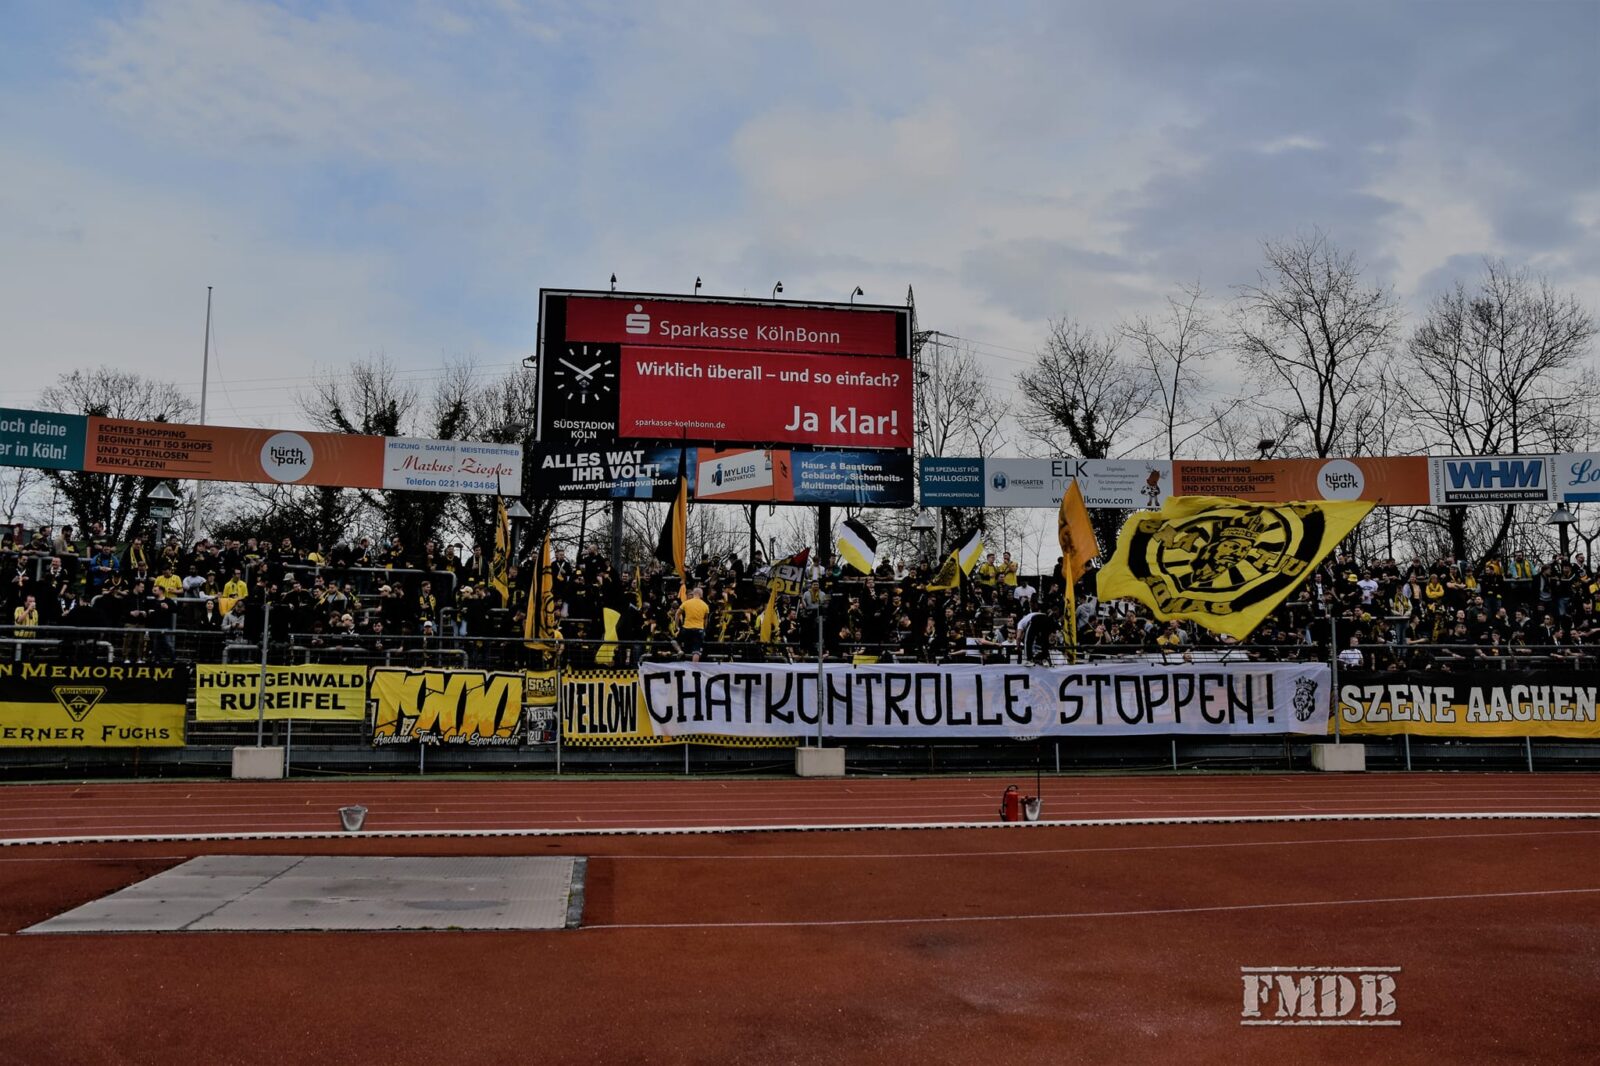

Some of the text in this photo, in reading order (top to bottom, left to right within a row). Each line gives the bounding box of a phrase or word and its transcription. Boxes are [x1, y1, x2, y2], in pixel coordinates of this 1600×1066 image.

[659, 320, 841, 345] Sparkasse KölnBonn
[637, 361, 702, 378] Wirklich
[707, 364, 762, 381] überall
[780, 369, 810, 383] und
[814, 373, 832, 384] so
[836, 371, 900, 388] einfach?
[0, 417, 67, 437] och deine
[553, 420, 615, 430] SÜDSTADION
[635, 418, 726, 429] sparkasse-koelnbonn.de
[784, 405, 898, 435] Ja klar!
[98, 424, 186, 438] ECHTES SHOPPING
[571, 428, 597, 439] KÖLN
[15, 440, 29, 457] in
[32, 442, 68, 460] Köln!
[97, 434, 213, 451] BEGINNT MIT 150 SHOPS
[388, 442, 520, 457] HEIZUNG SANITÄR MEISTERBETRIEB
[96, 445, 189, 460] UND KOSTENLOSEN
[270, 446, 303, 457] hürth
[95, 455, 166, 469] PARKPLÄTZEN!
[277, 456, 307, 467] park
[393, 455, 513, 478] Markus Ziegler
[541, 450, 645, 469] ALLES WAT
[801, 461, 883, 472] Haus- & Baustrom
[572, 463, 661, 482] IHR VOLT!
[724, 464, 756, 478] MYLIUS
[801, 471, 904, 482] Gebäude-, Sicherheits-
[967, 465, 979, 473] FÜR
[1052, 461, 1088, 477] ELK
[1446, 460, 1542, 489] WHM
[405, 477, 436, 486] Telefon
[559, 477, 678, 492] www.mylius-innovation.d
[723, 472, 757, 483] INNOVATION
[1325, 473, 1354, 482] hürth
[801, 481, 885, 492] Multimediatechnik
[1333, 481, 1358, 491] park
[20, 662, 175, 682] MEMORIAM
[199, 671, 364, 688] HÜRTGENWALD
[59, 687, 101, 695] Alemannia
[528, 678, 555, 691] 50+1
[220, 692, 346, 710] RUREIFEL
[644, 670, 1275, 725] CHATKONTROLLE STOPPEN!
[1340, 684, 1597, 723] SZENE AACHEN
[530, 709, 555, 720] NEIN
[563, 682, 638, 733] YELLOW
[0, 725, 85, 742] ERNER
[374, 728, 520, 747] Aachener Turn- und Sportverein
[528, 730, 541, 741] ZU
